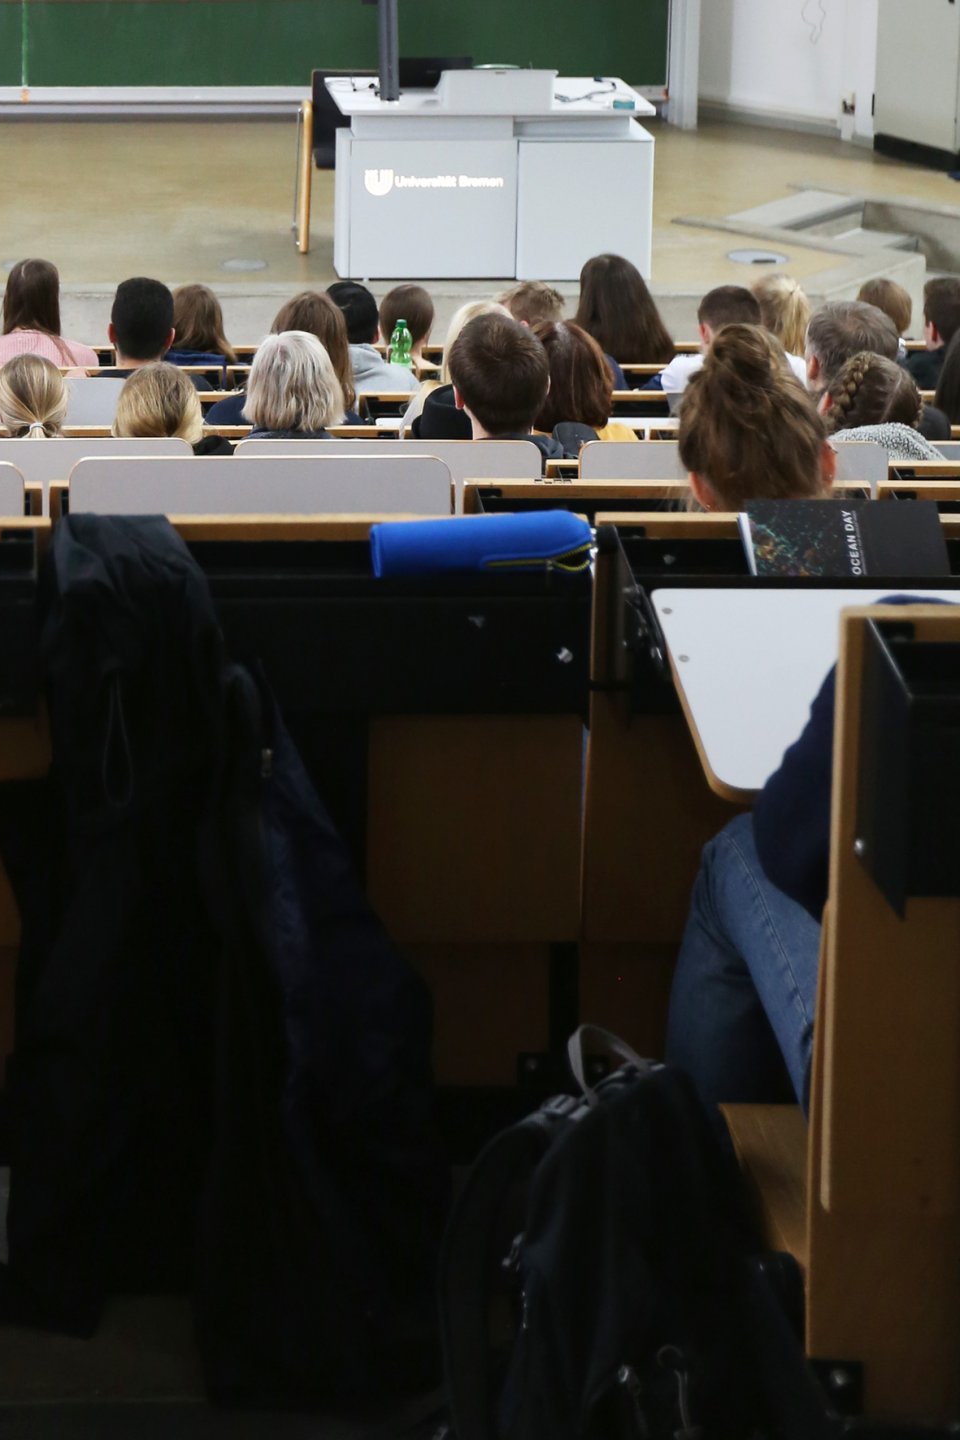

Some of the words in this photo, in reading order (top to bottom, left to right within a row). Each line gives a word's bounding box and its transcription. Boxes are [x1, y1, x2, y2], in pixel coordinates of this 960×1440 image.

[395, 174, 457, 188] Universität
[460, 175, 504, 188] Bremen
[841, 510, 855, 531] DAY
[847, 535, 862, 575] OCEAN
